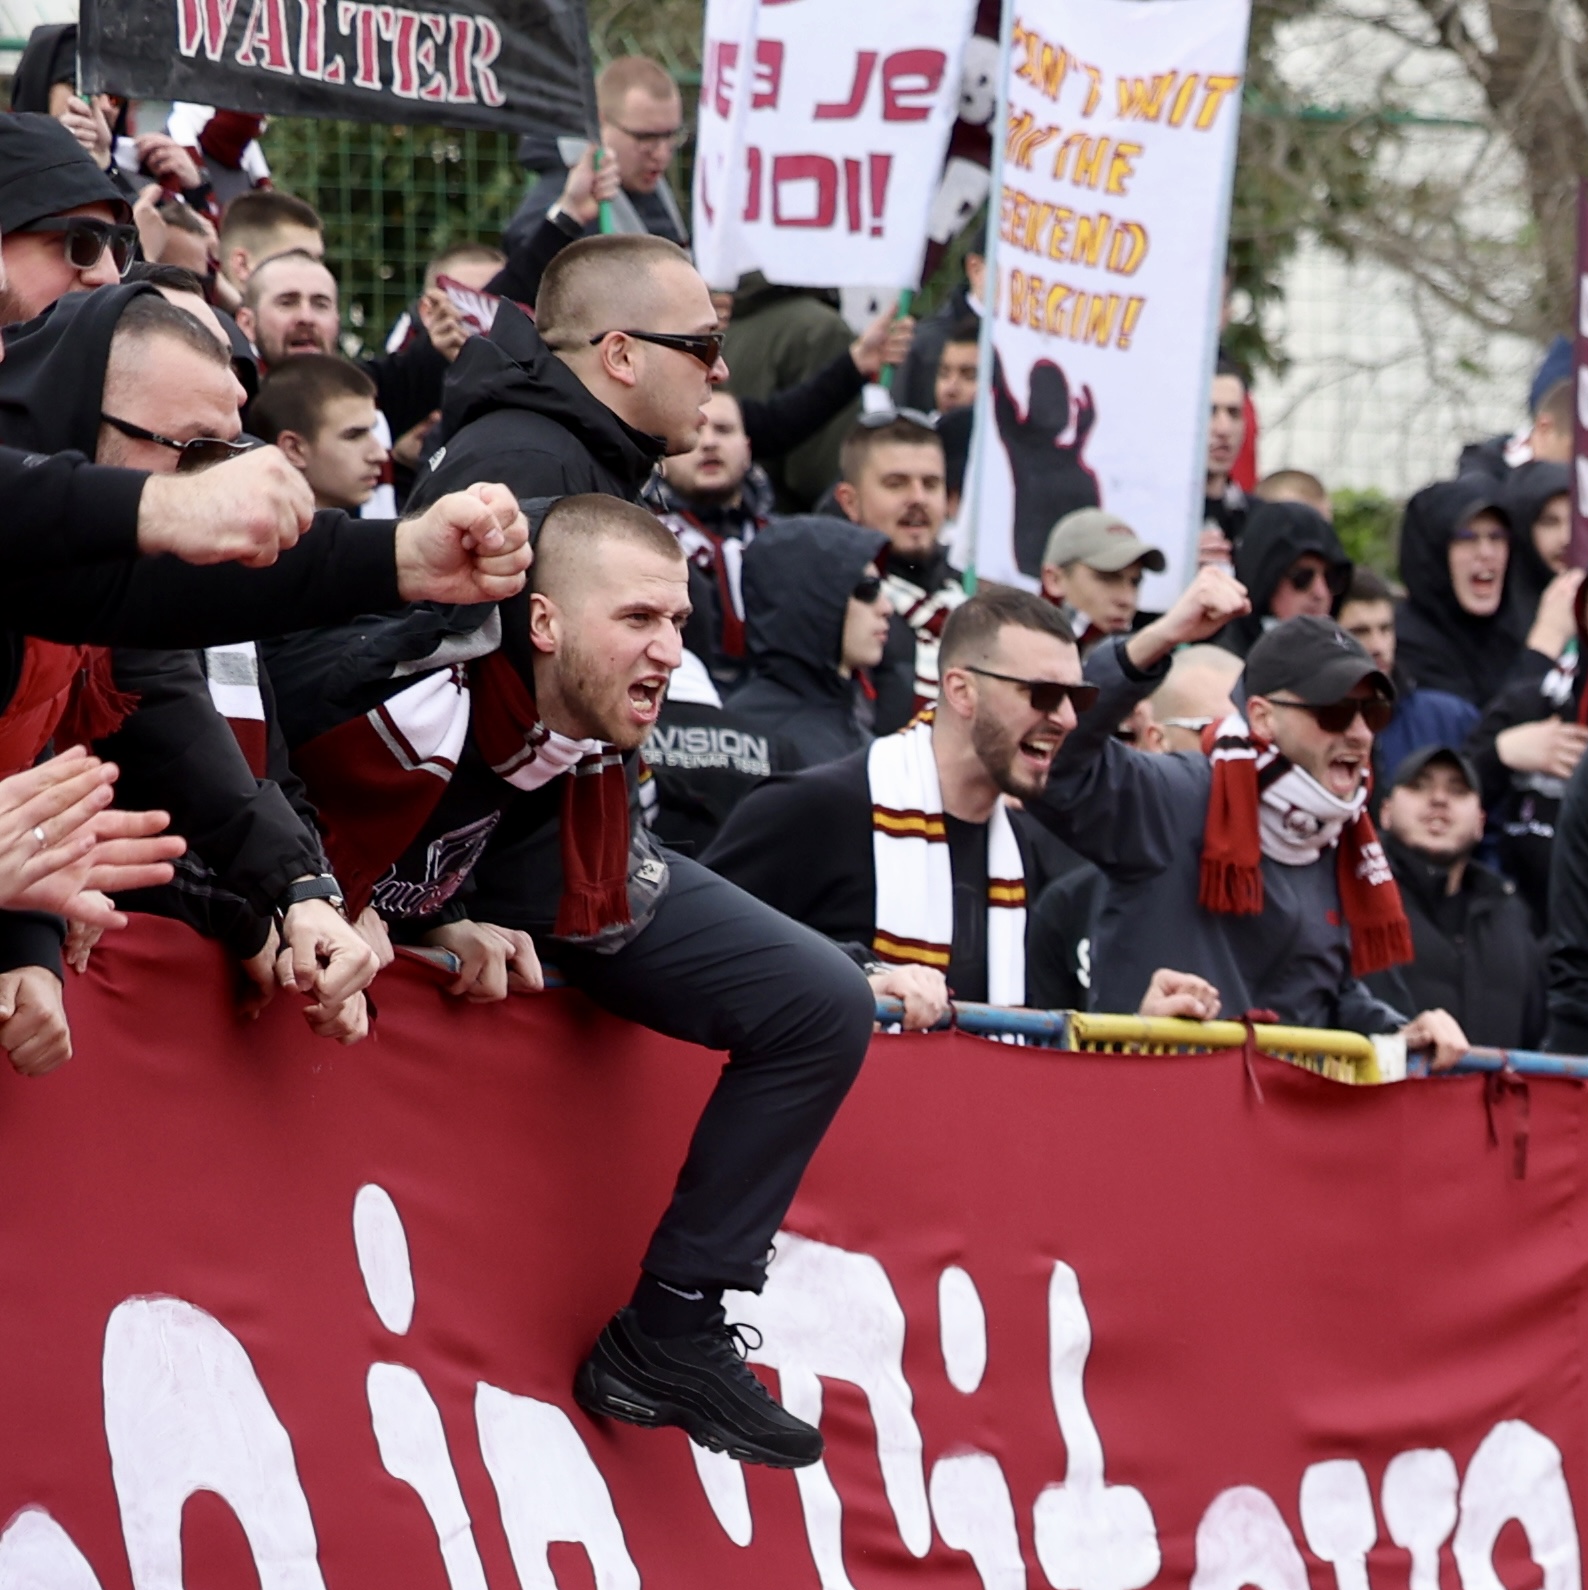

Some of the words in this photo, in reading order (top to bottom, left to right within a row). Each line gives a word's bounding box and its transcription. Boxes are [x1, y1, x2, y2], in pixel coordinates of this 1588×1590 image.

[176, 0, 506, 107] WALTER
[1052, 132, 1144, 197] THE
[1009, 268, 1146, 351] BEGIN!
